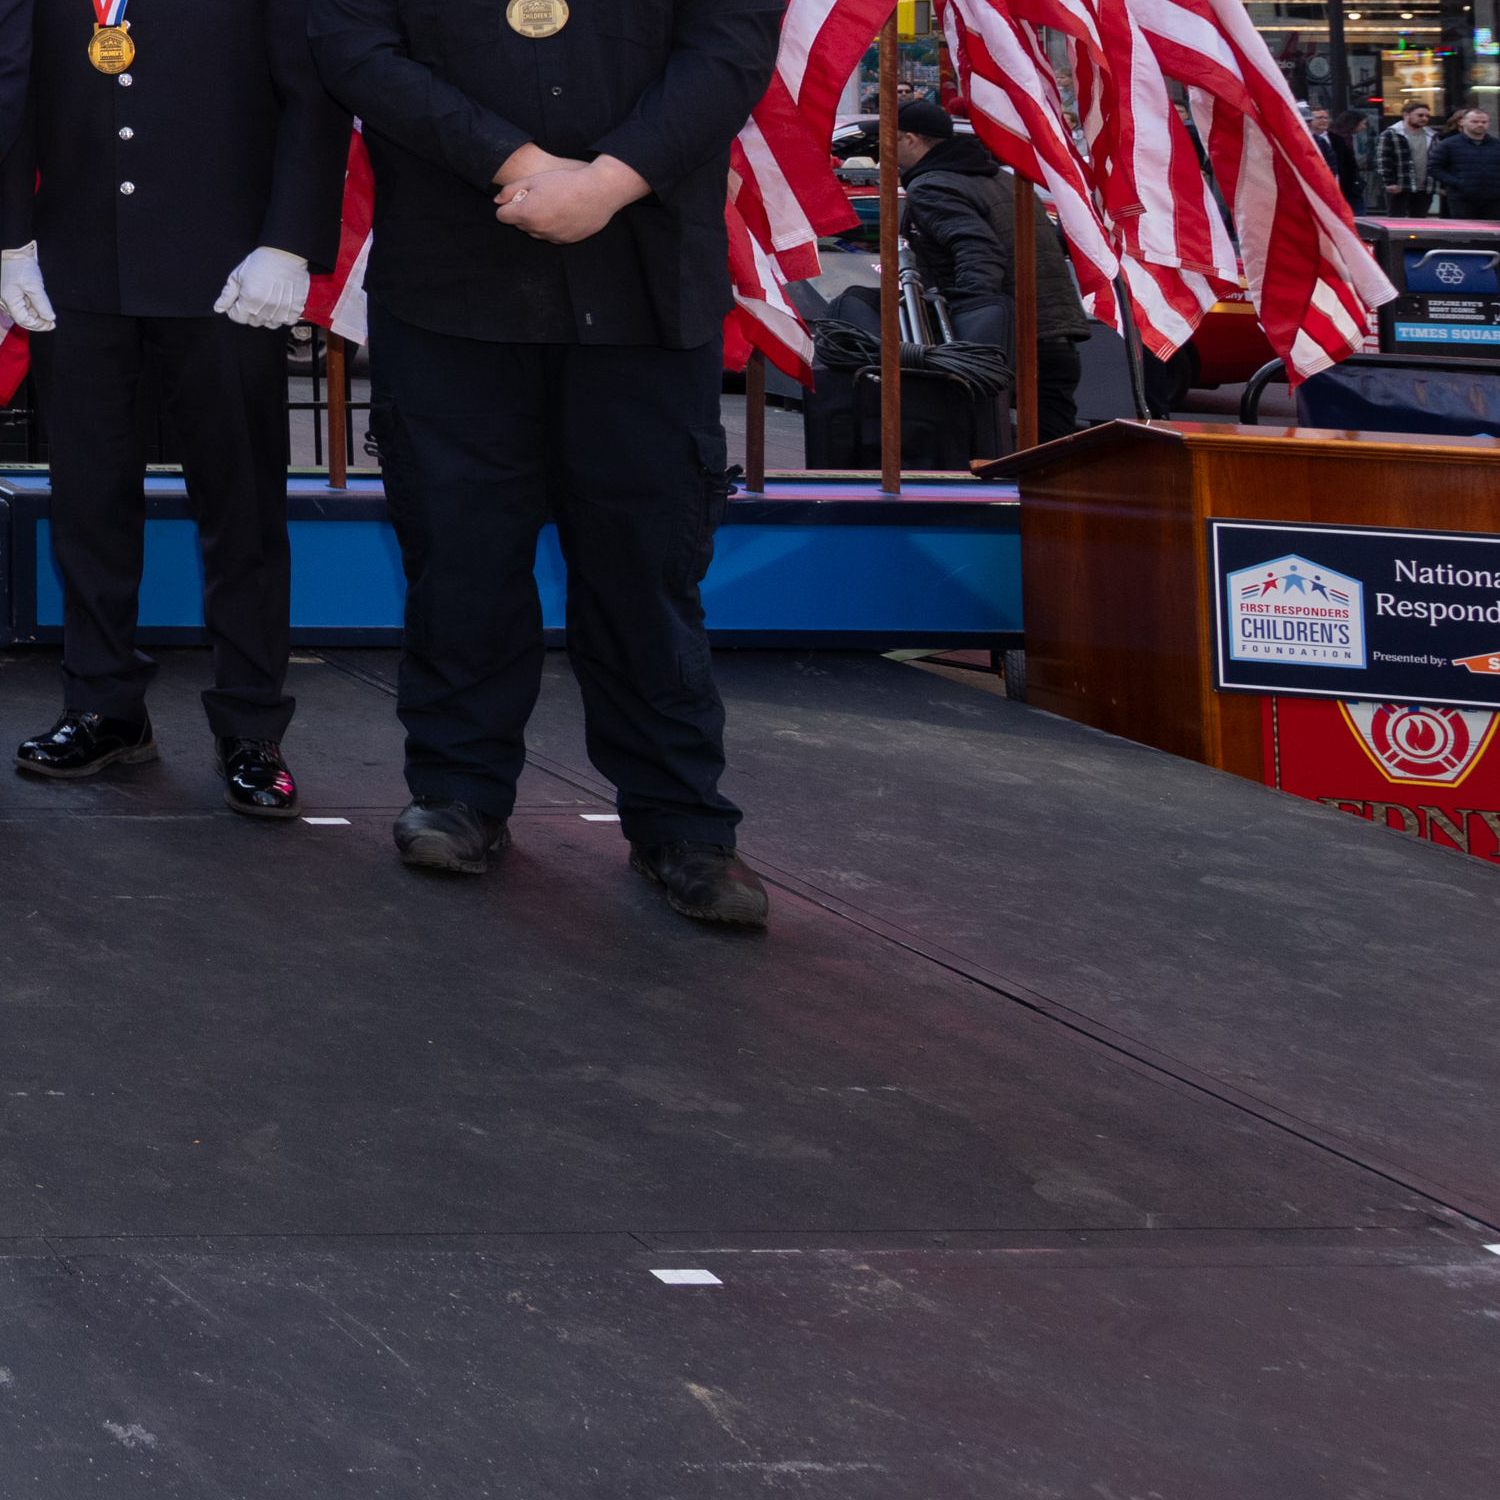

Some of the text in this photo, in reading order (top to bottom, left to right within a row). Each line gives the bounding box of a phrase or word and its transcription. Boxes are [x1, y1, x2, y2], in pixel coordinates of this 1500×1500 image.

[1398, 327, 1448, 339] TIMES
[1240, 603, 1350, 619] FIRST RESPONDERS
[1241, 617, 1351, 645] CHILDREN'S
[1242, 644, 1352, 659] FOUNDATION
[1373, 651, 1447, 666] Presented by:
